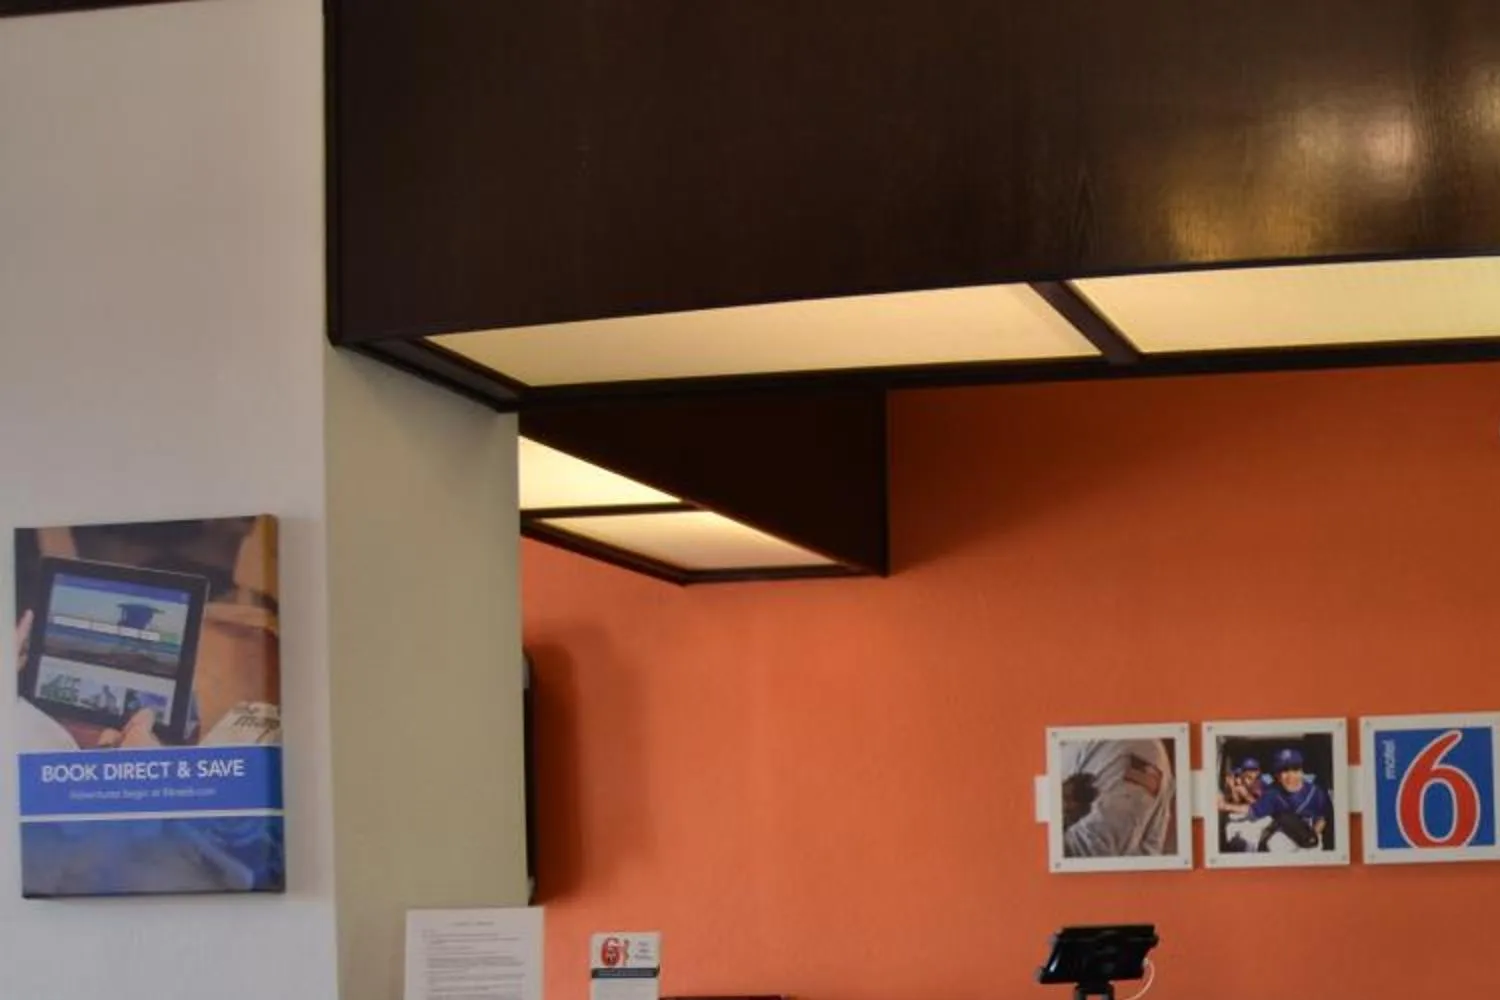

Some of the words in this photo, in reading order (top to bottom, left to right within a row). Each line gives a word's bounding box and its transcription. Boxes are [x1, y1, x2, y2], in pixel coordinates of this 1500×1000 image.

[41, 763, 99, 783] BOOK
[103, 760, 171, 781] DIRECT
[177, 760, 191, 778] &
[197, 758, 246, 778] SAVE
[1382, 739, 1397, 780] motel
[1396, 729, 1481, 849] 6
